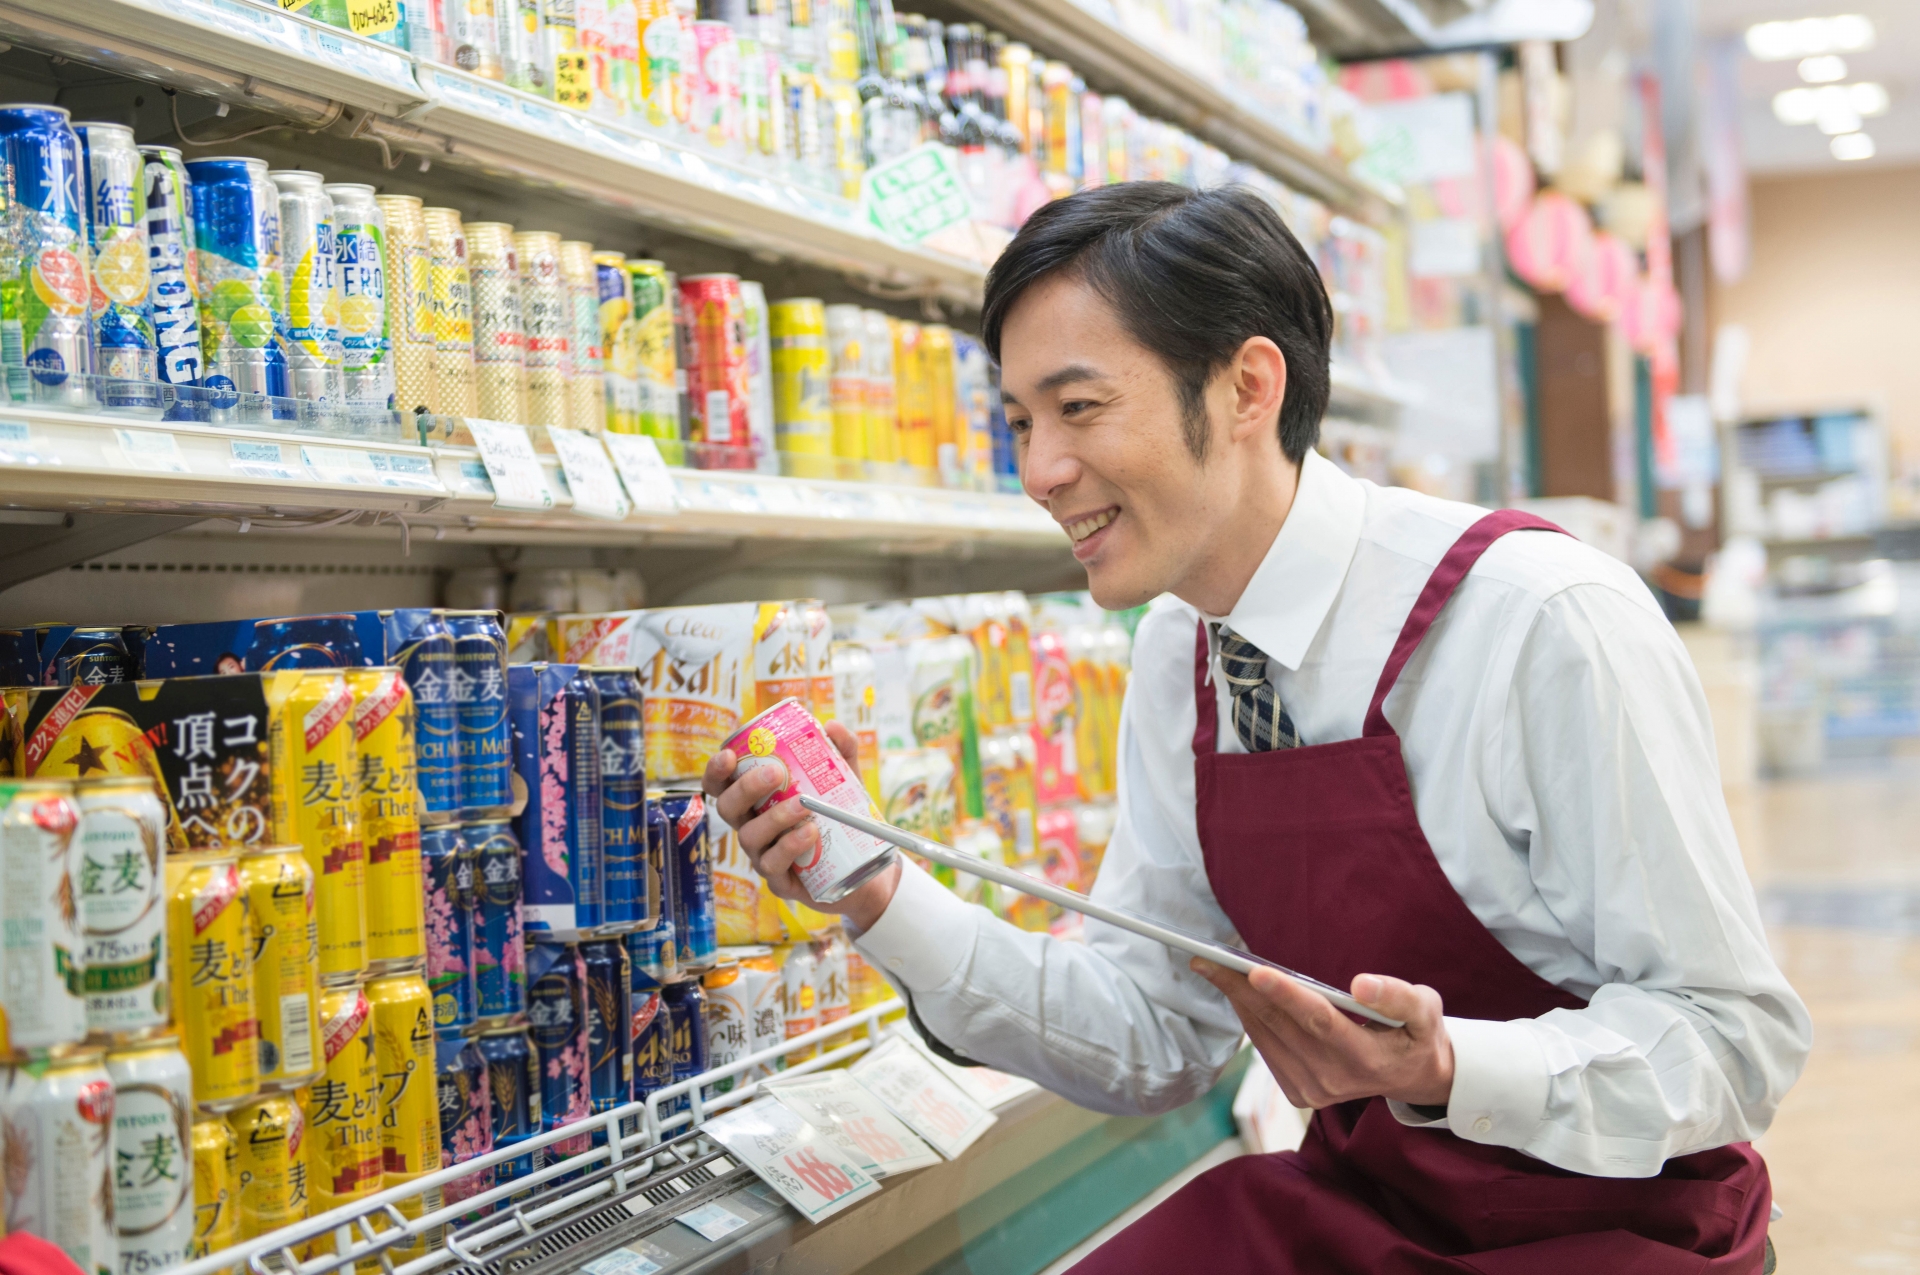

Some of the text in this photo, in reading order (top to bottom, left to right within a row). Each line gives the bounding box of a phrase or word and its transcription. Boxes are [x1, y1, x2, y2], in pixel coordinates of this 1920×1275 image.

[40, 166, 78, 213] 氷
[97, 179, 135, 228] 結
[336, 237, 377, 262] 氷結
[145, 162, 203, 384] STRONG
[84, 665, 125, 686] 金麦
[113, 722, 168, 764] NEW!
[172, 711, 220, 849] 頂点へ。
[223, 714, 265, 845] コクの
[372, 797, 410, 820] The
[528, 999, 574, 1027] 金麦
[326, 1124, 373, 1147] The
